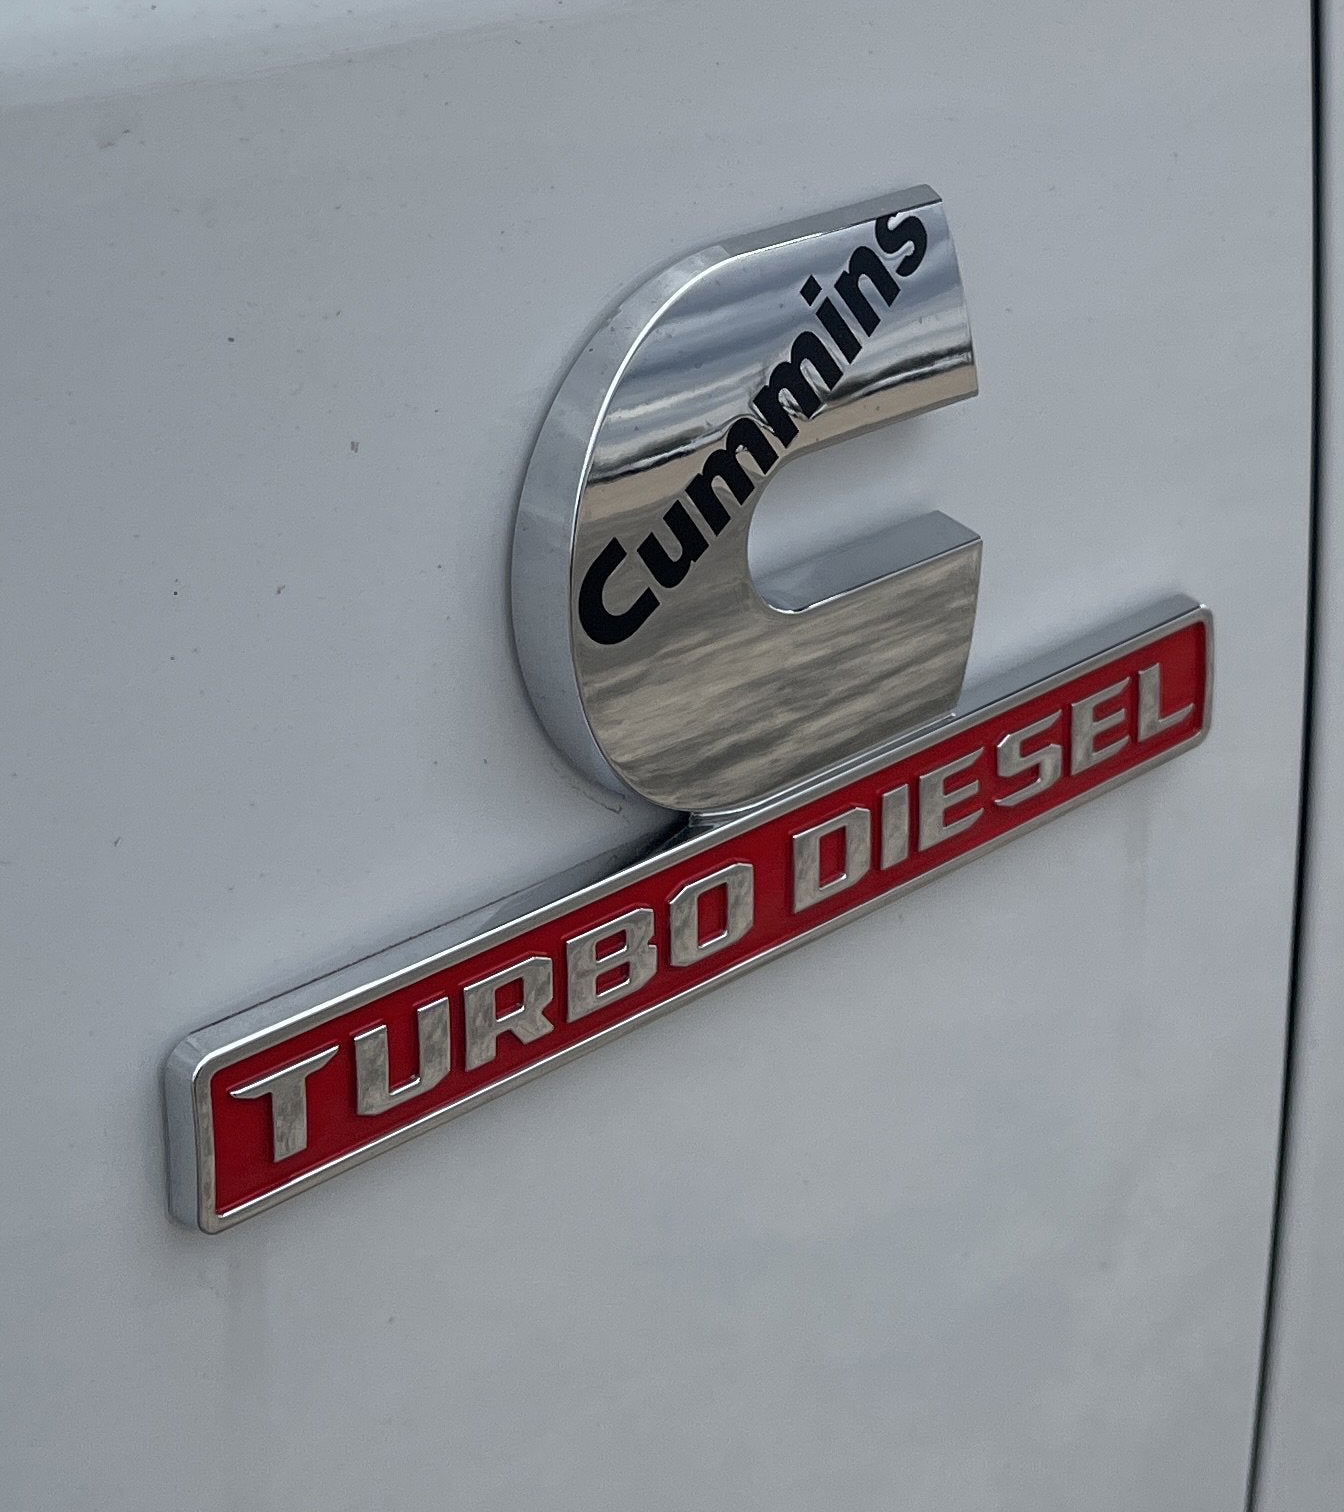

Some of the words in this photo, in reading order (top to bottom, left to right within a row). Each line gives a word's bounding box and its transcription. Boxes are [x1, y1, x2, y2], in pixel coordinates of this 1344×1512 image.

[578, 211, 929, 646] Cummins
[229, 861, 755, 1164] TURBO
[792, 662, 1196, 915] DIESEL
